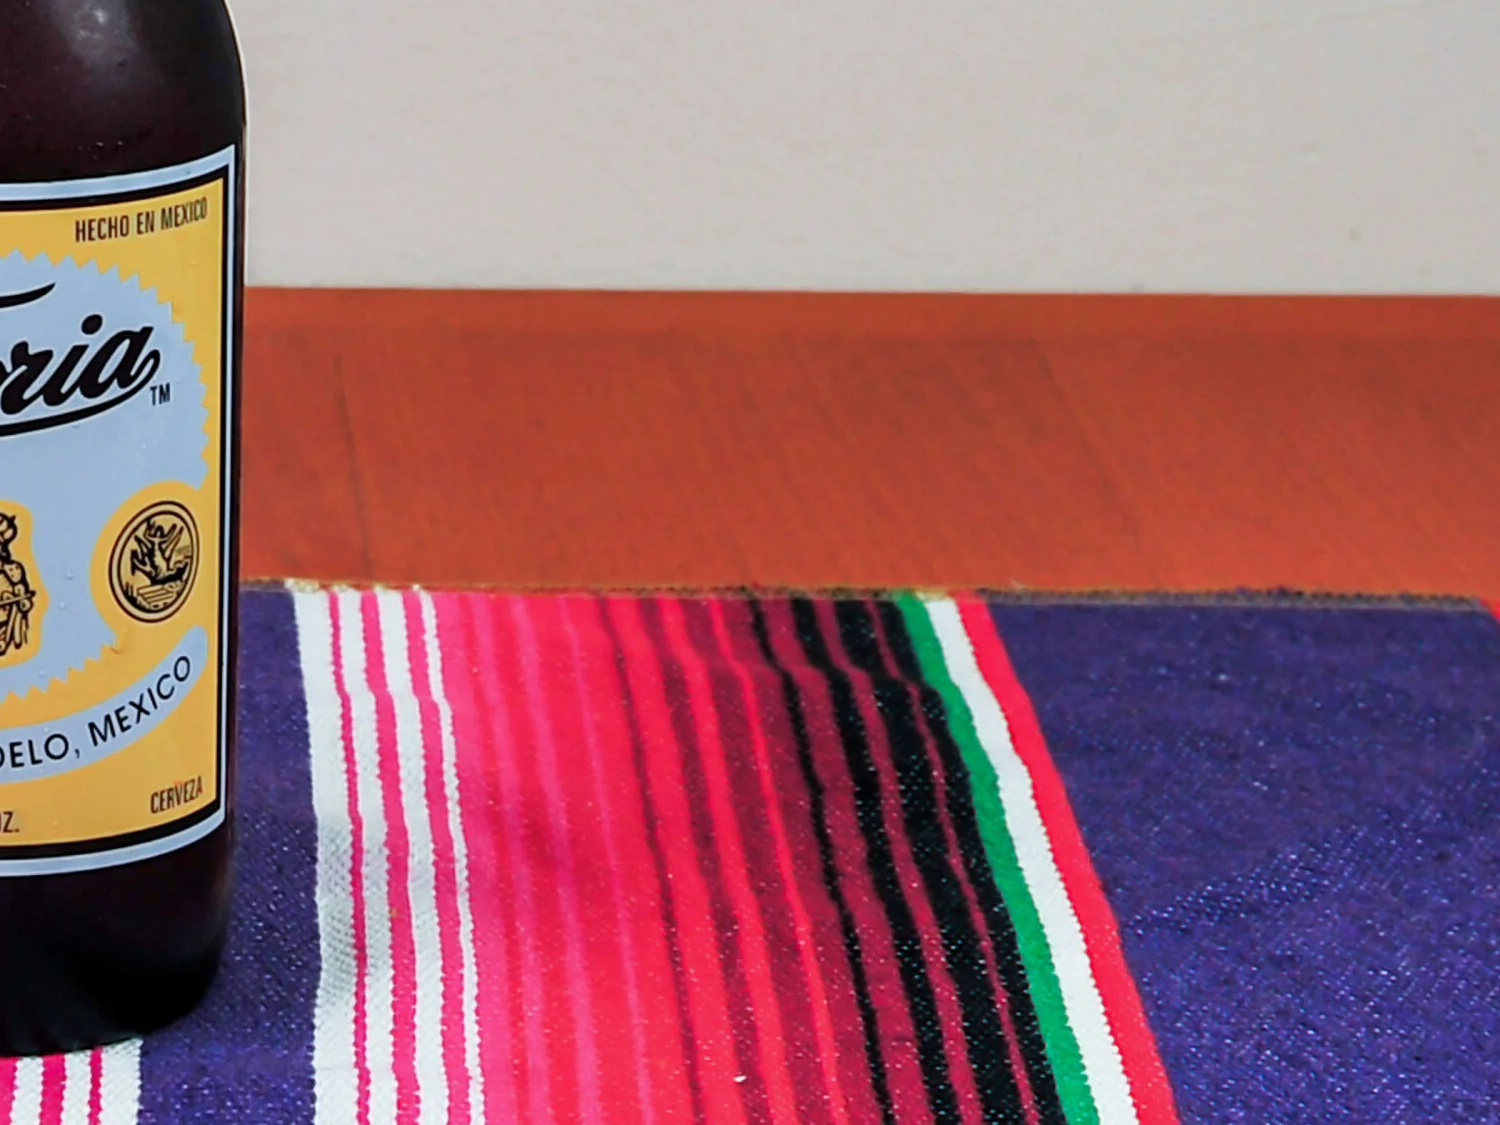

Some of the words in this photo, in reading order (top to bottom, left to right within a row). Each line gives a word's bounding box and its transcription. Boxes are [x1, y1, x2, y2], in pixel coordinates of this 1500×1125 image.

[75, 214, 130, 243] HECHO
[136, 210, 155, 235] EN
[160, 196, 208, 230] MEXICO
[150, 384, 171, 406] TM
[88, 655, 191, 747] MEXICO
[150, 775, 203, 815] CERVEZA
